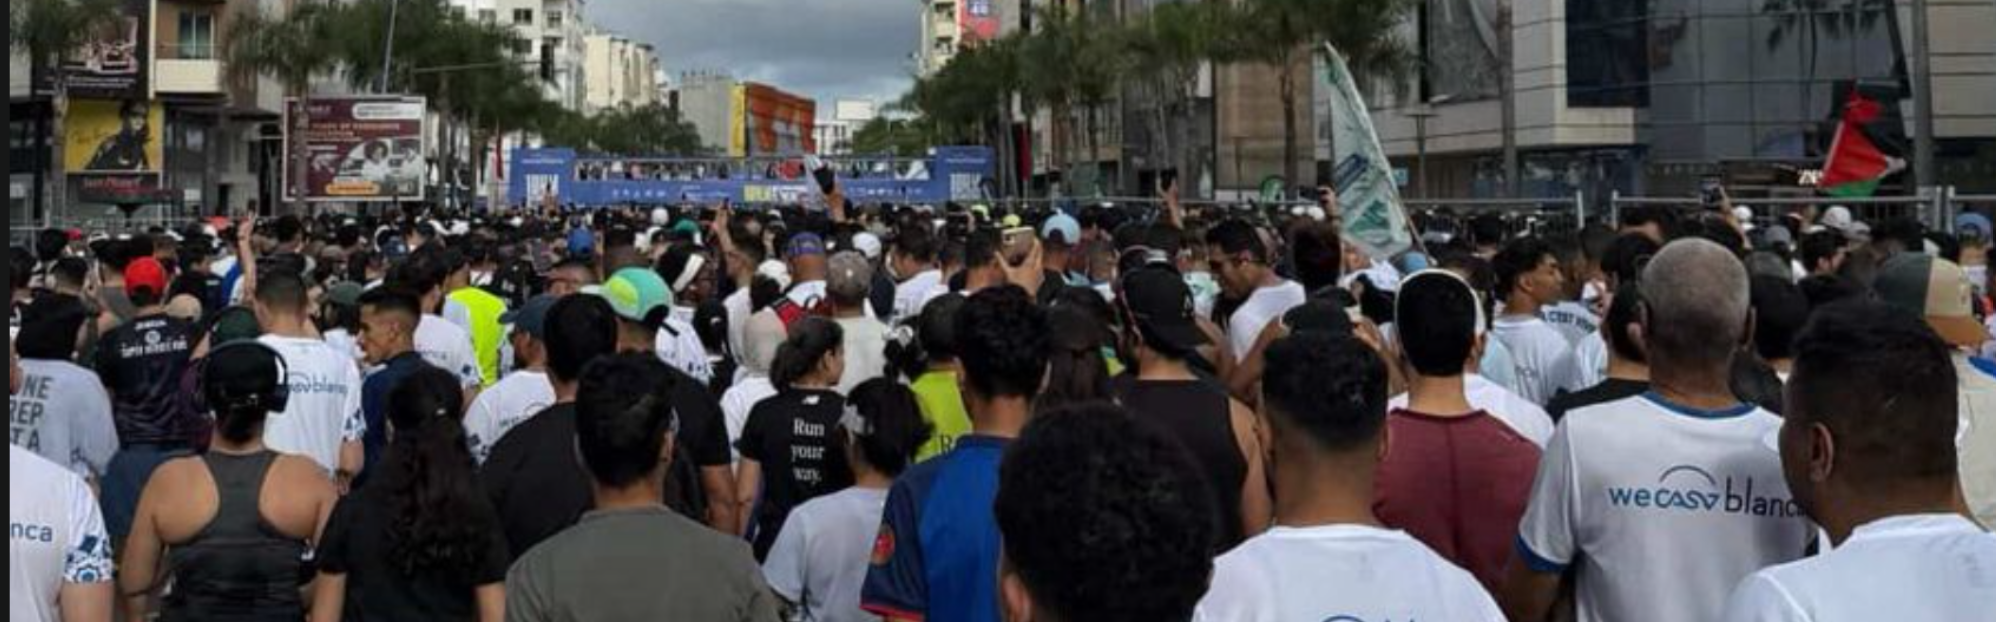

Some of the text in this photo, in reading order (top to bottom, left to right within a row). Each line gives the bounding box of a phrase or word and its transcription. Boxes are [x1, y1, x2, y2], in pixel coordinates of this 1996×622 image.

[794, 417, 825, 437] Run
[790, 444, 825, 463] your
[792, 467, 823, 487] way.
[11, 522, 53, 542] nca
